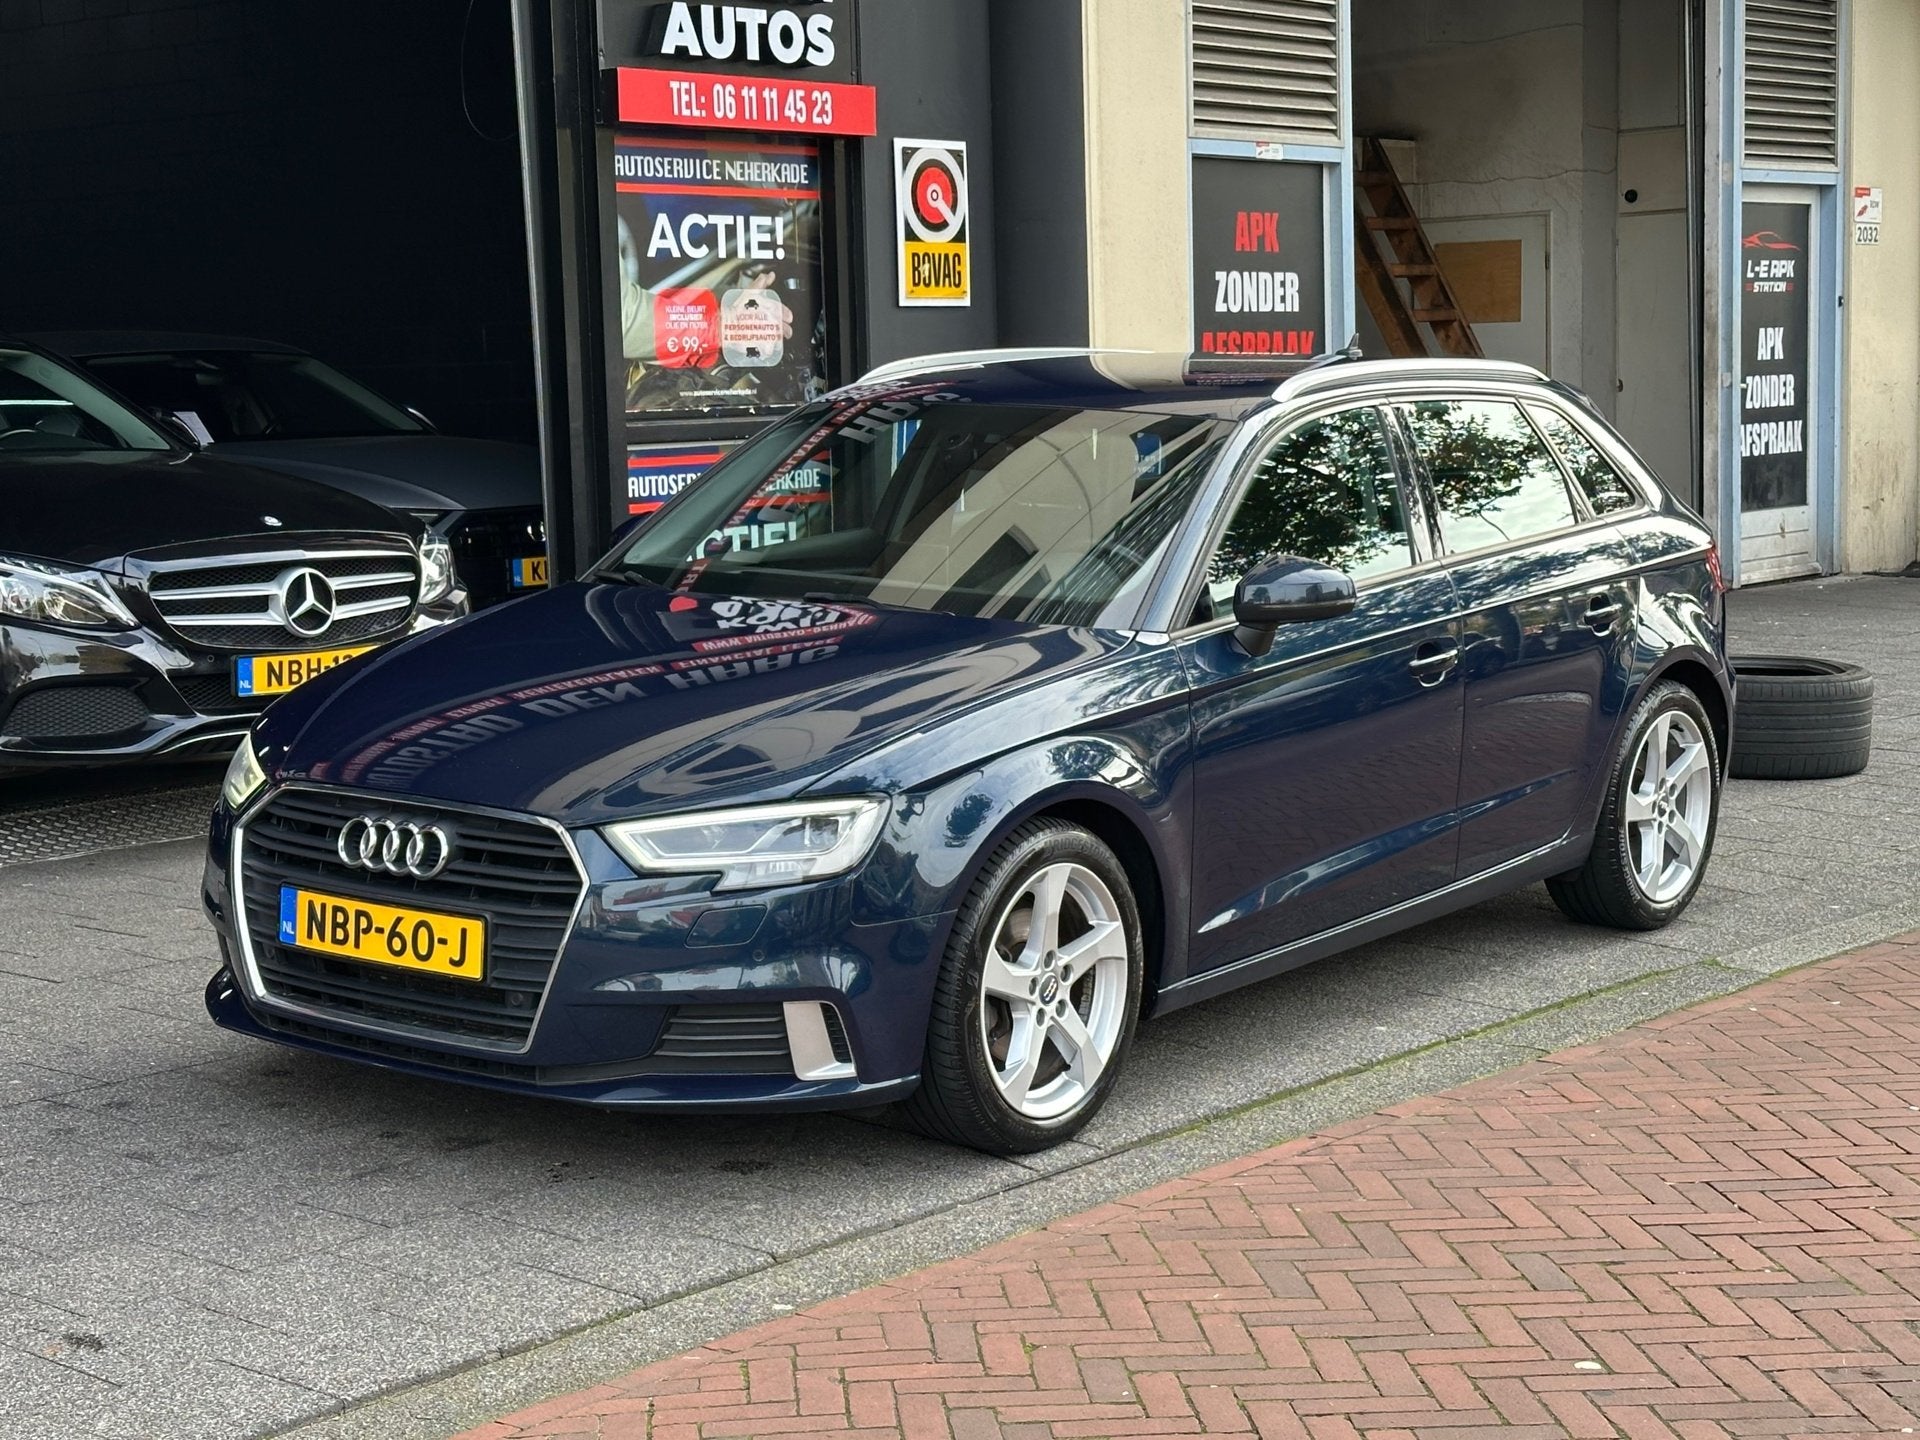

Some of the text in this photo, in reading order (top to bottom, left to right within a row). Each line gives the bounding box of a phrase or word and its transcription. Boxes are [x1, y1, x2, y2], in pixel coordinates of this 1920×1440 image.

[661, 1, 835, 66] AUTOS
[669, 80, 833, 126] TEL: 06 11 11 45 23
[614, 154, 809, 185] AUTOSERVICE NEHERKADE
[646, 212, 786, 261] ACTIE!
[1235, 212, 1280, 253] APK
[1857, 226, 1879, 243] 2032
[912, 252, 962, 289] BOVAG
[1746, 260, 1796, 278] L-E APK
[1753, 281, 1787, 293] STATION
[1214, 270, 1300, 313] ZONDER
[667, 336, 709, 354] € 99,-
[724, 323, 780, 331] PERSONENAUTO'S
[1757, 326, 1784, 361] APK
[1745, 373, 1795, 410] ZONDER
[1740, 419, 1803, 457] AFSPRAAK
[240, 680, 252, 689] NL
[282, 920, 295, 935] NL
[305, 899, 468, 968] NBP-60-J
